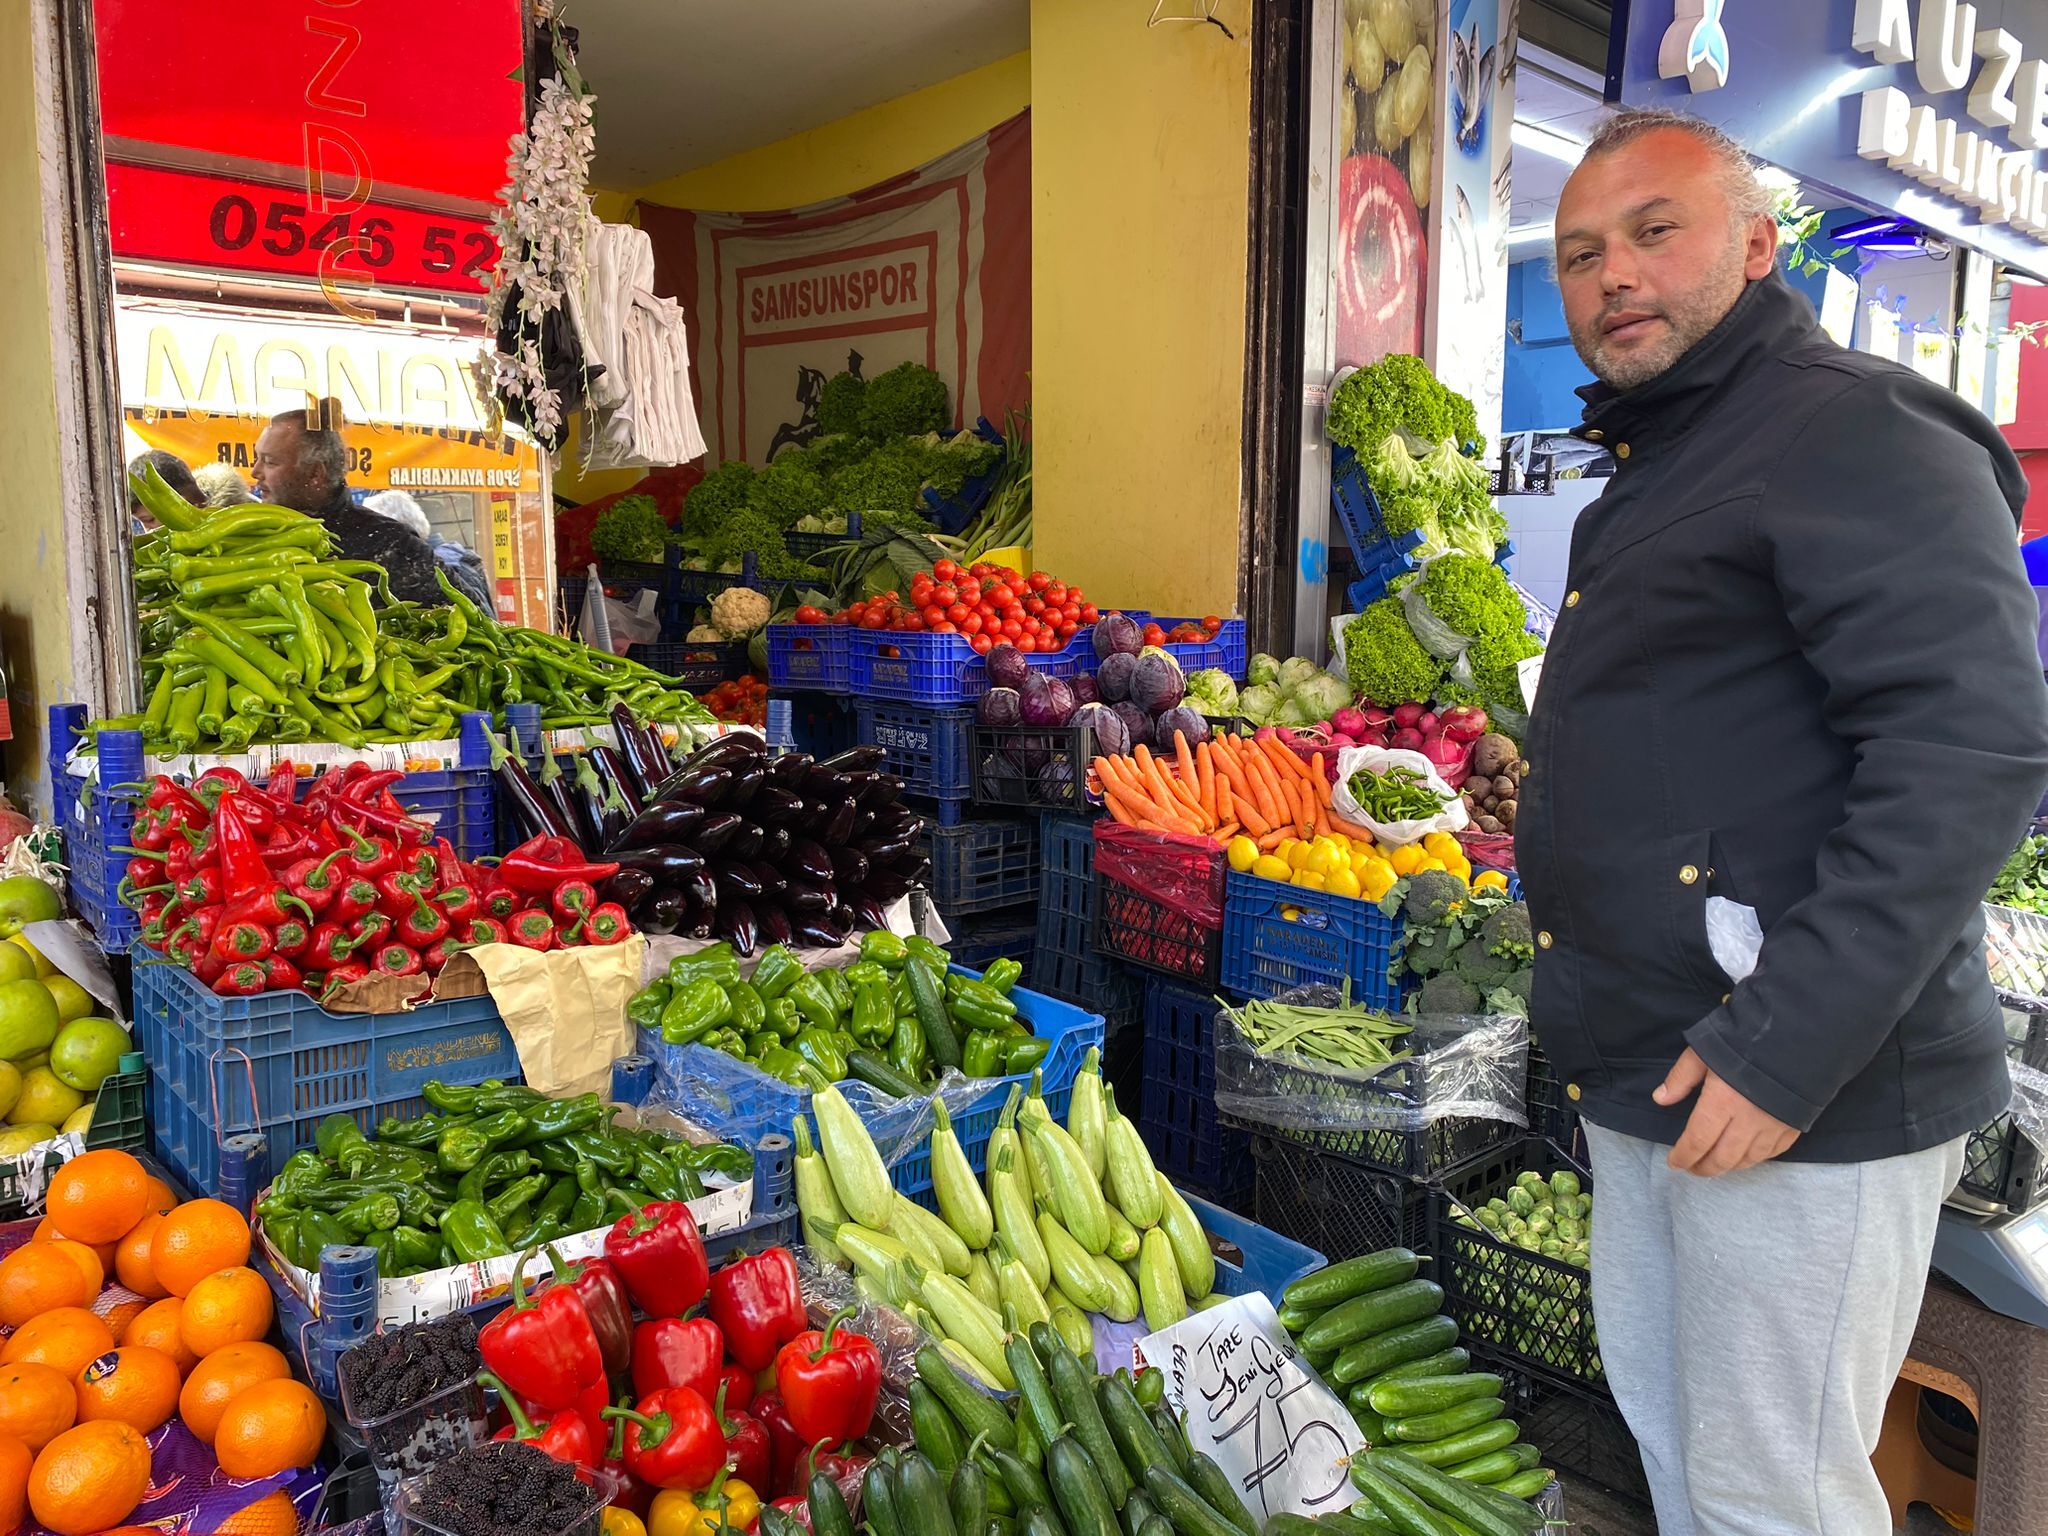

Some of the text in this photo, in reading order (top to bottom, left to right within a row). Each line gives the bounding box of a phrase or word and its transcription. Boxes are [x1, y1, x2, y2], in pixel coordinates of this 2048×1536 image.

[303, 0, 377, 323] ZDE
[209, 194, 395, 268] 0546
[750, 261, 918, 324] SAMSUNSPOR
[876, 731, 928, 750] ZAFER
[1197, 1318, 1243, 1373] TAZE
[1211, 1377, 1350, 1520] 75
